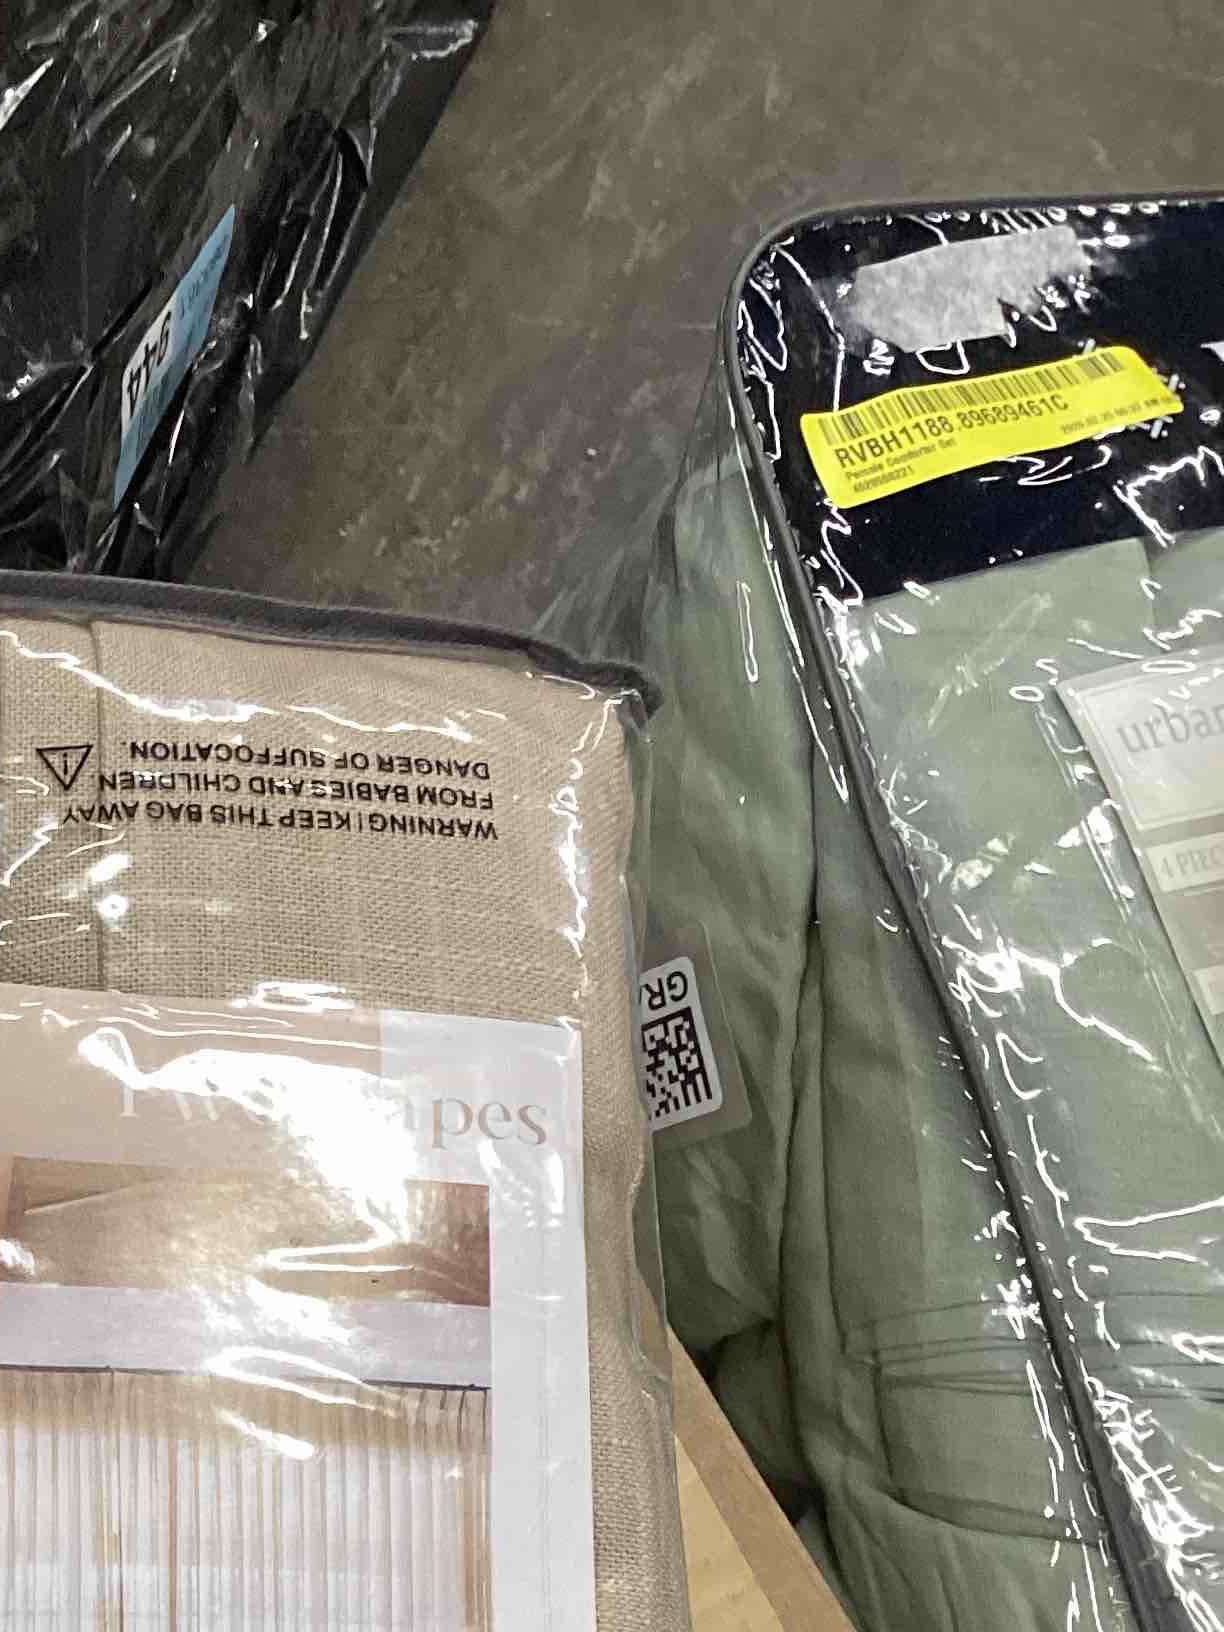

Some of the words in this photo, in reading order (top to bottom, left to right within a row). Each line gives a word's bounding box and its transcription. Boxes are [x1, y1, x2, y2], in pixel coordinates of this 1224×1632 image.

[333, 749, 371, 770] OF
[377, 752, 491, 781] DANGER
[310, 778, 410, 804] BABIES
[416, 785, 494, 810] FROM
[62, 799, 139, 824] AWAY
[145, 800, 203, 823] BAG
[210, 803, 274, 827] THIS
[279, 808, 351, 832] KEEP
[638, 971, 688, 1011] GR
